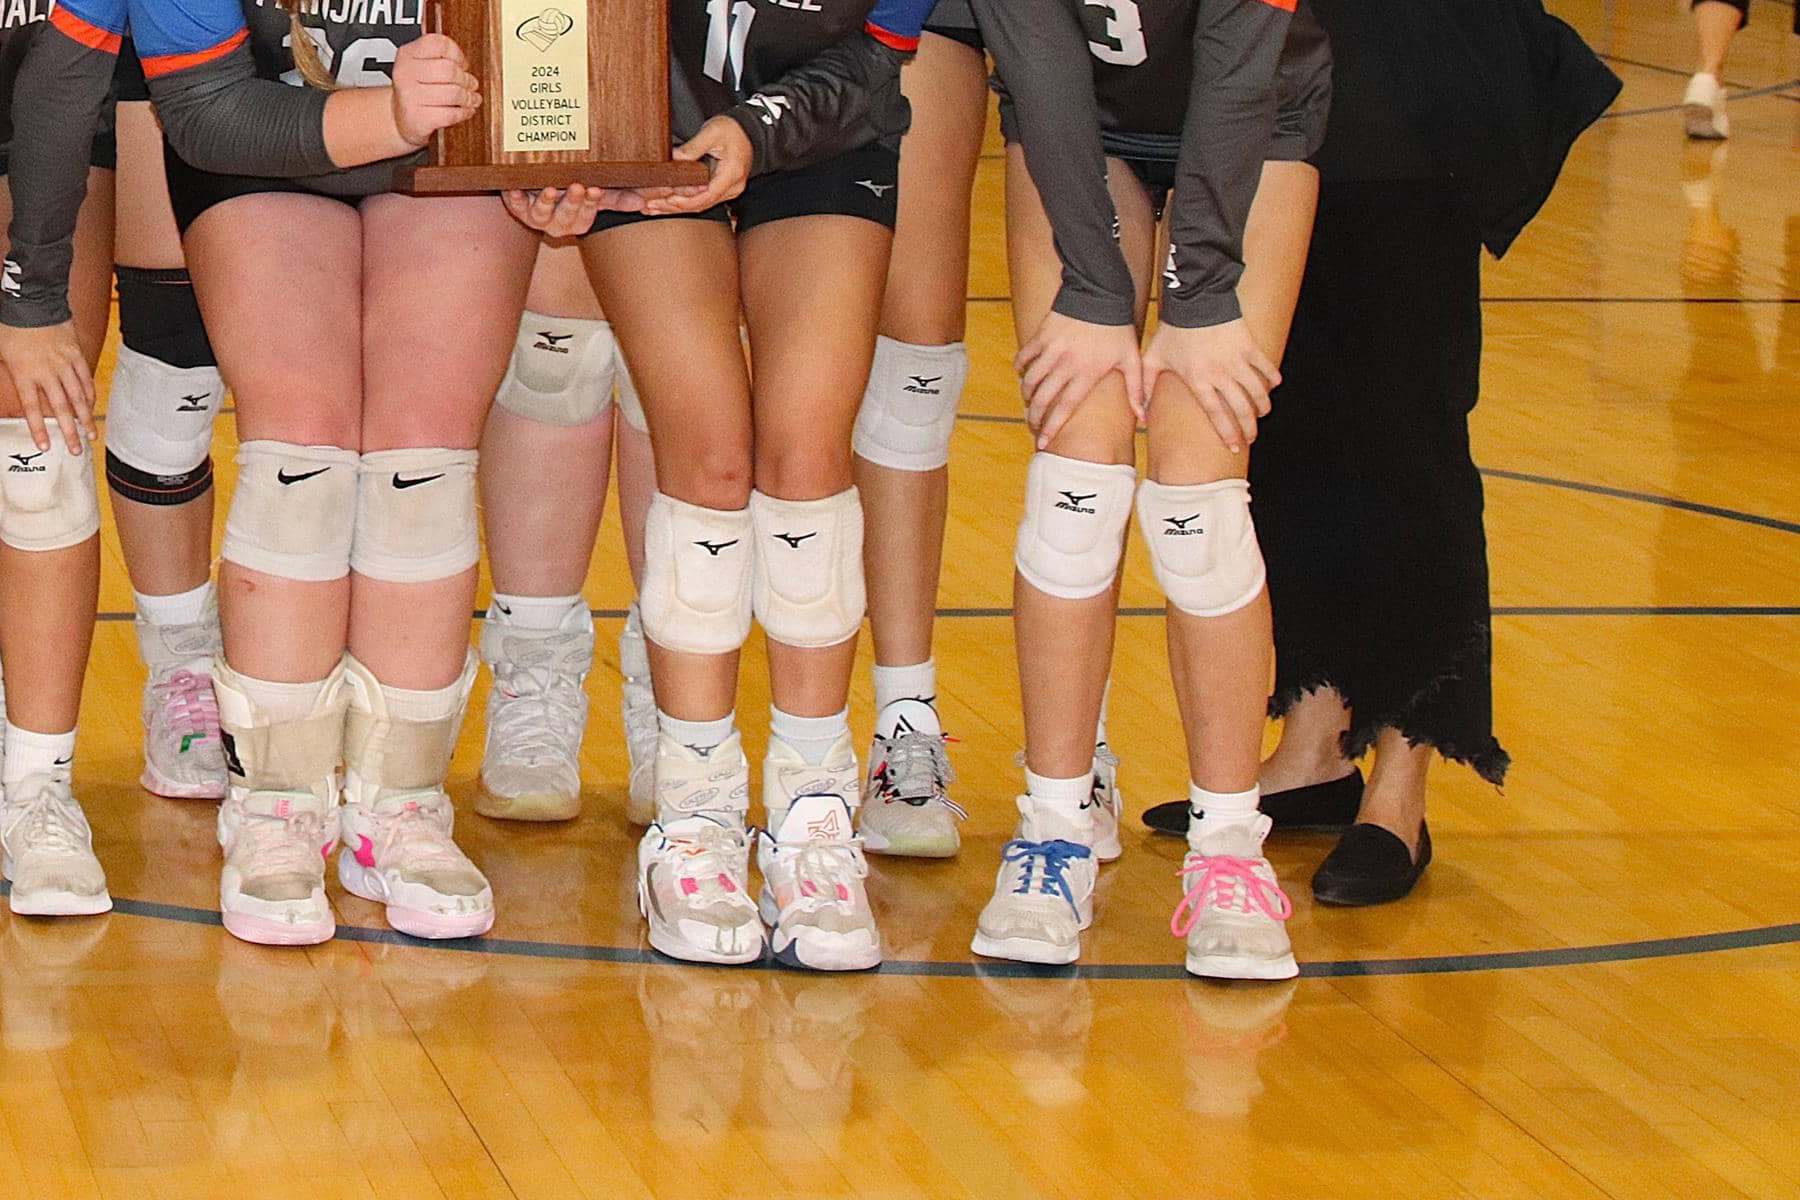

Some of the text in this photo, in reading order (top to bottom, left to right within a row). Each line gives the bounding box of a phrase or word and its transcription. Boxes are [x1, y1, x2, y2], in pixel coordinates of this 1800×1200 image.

[531, 66, 559, 77] 2024
[529, 83, 562, 93] GIRLS
[512, 98, 581, 110] VOLLEYBALL
[520, 115, 572, 126] DISTRICT
[517, 131, 577, 142] CHAMPION
